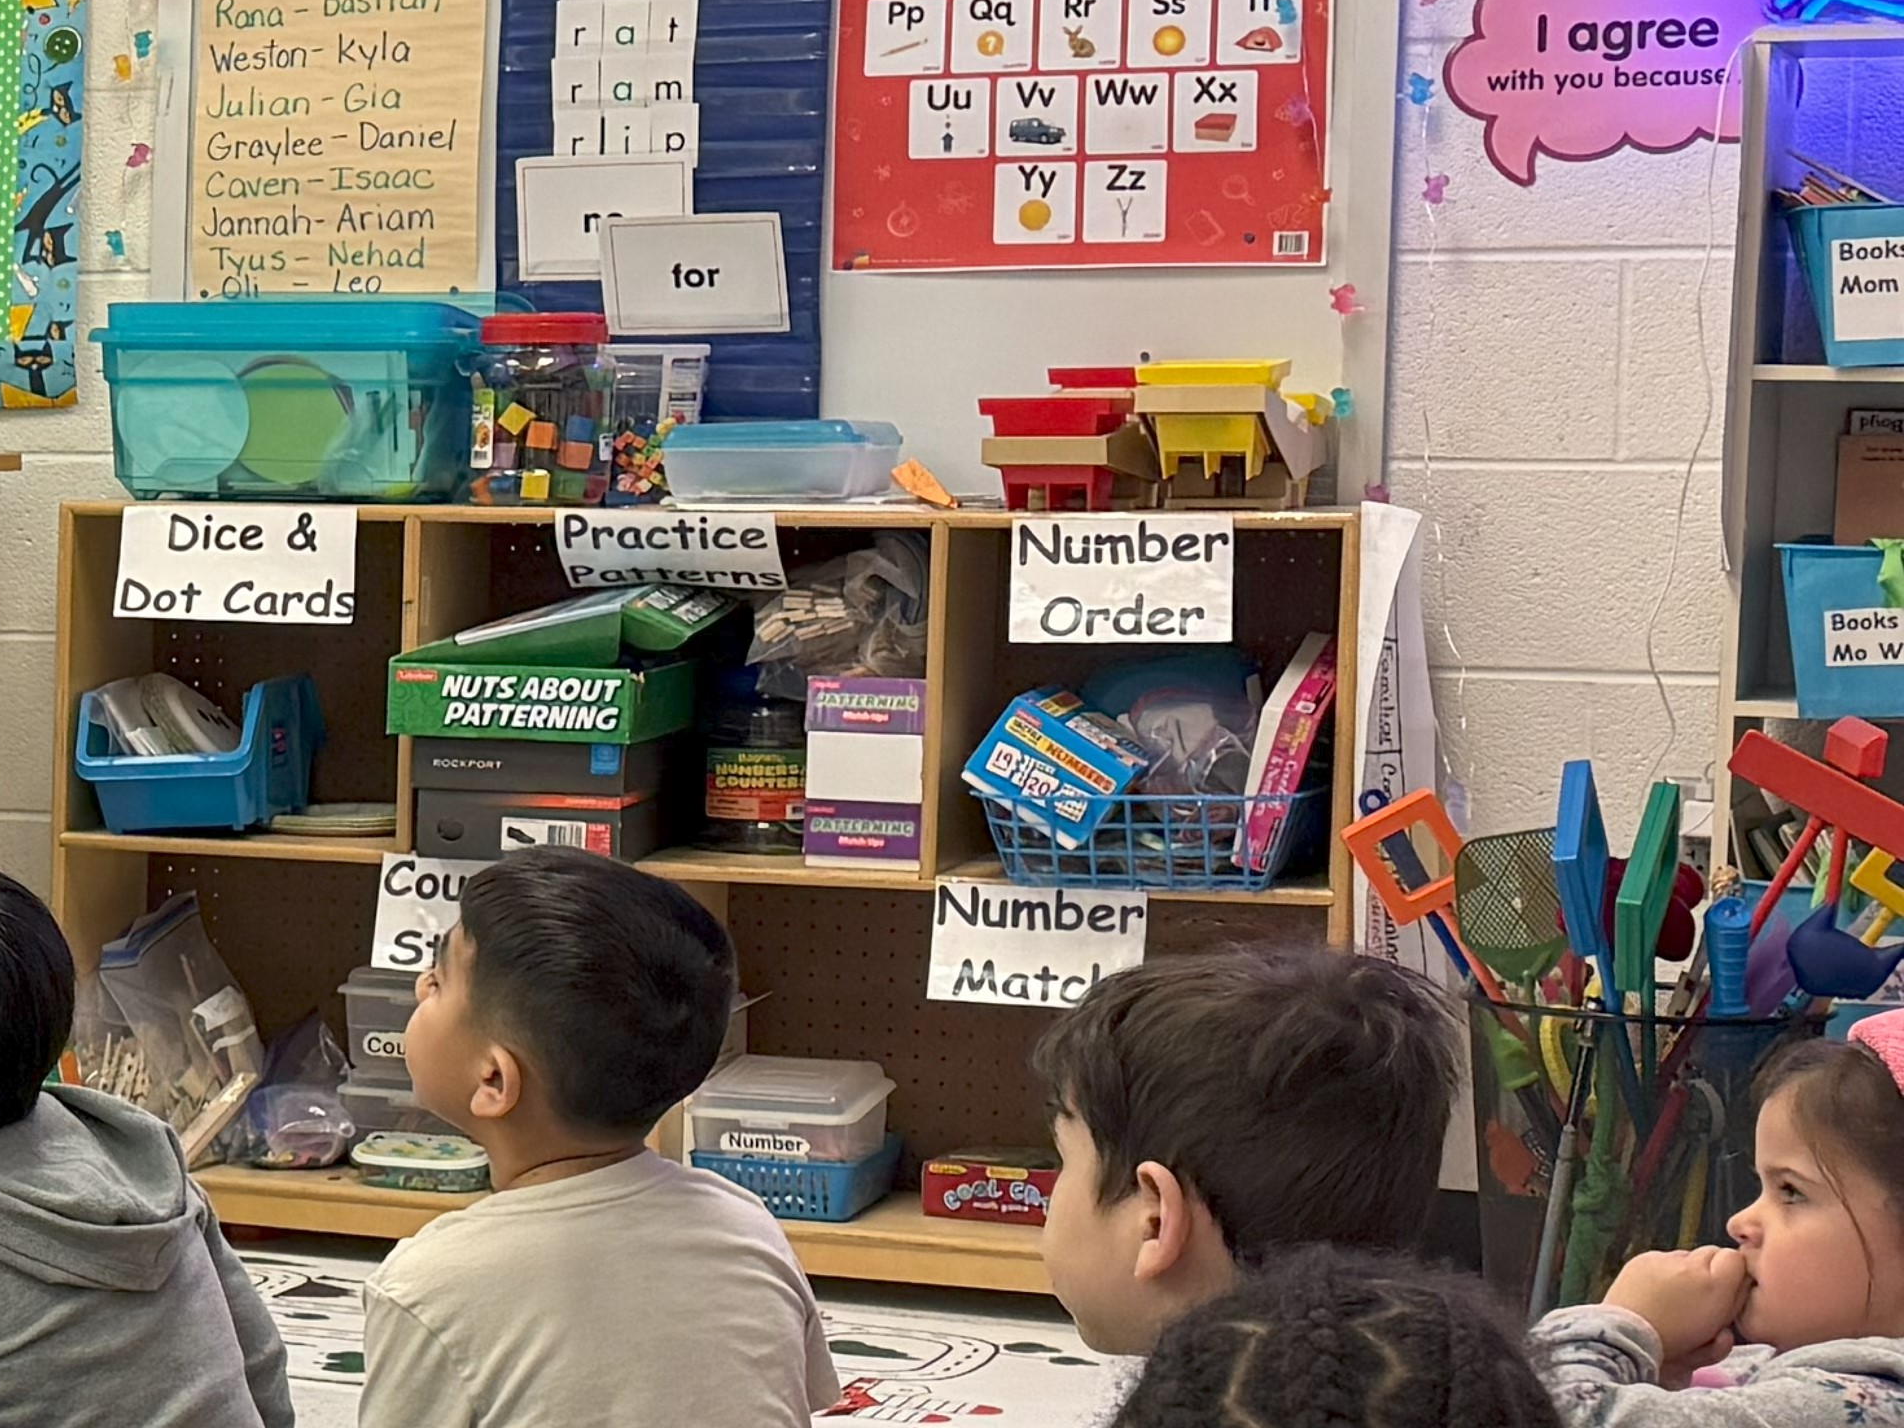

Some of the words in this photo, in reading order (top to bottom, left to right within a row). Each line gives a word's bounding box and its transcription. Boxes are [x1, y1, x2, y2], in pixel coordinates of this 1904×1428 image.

[1537, 14, 1547, 52] I
[1568, 16, 1720, 61] agree
[206, 84, 309, 119] Julian
[344, 83, 401, 113] Gia
[672, 263, 719, 288] for
[169, 514, 263, 551] Dice
[287, 513, 317, 552] &
[564, 514, 767, 550] Practice
[1020, 520, 1229, 565] Number
[120, 578, 201, 613] Dot
[224, 581, 356, 620] Cards
[1040, 595, 1205, 637] Order
[1831, 612, 1898, 631] Books
[442, 675, 517, 706] NUTS
[521, 677, 621, 701] ABOUT
[445, 702, 618, 730] PATTERNING
[433, 759, 501, 769] ROCKPORT
[938, 885, 1144, 934] Number
[728, 1131, 804, 1155] Number
